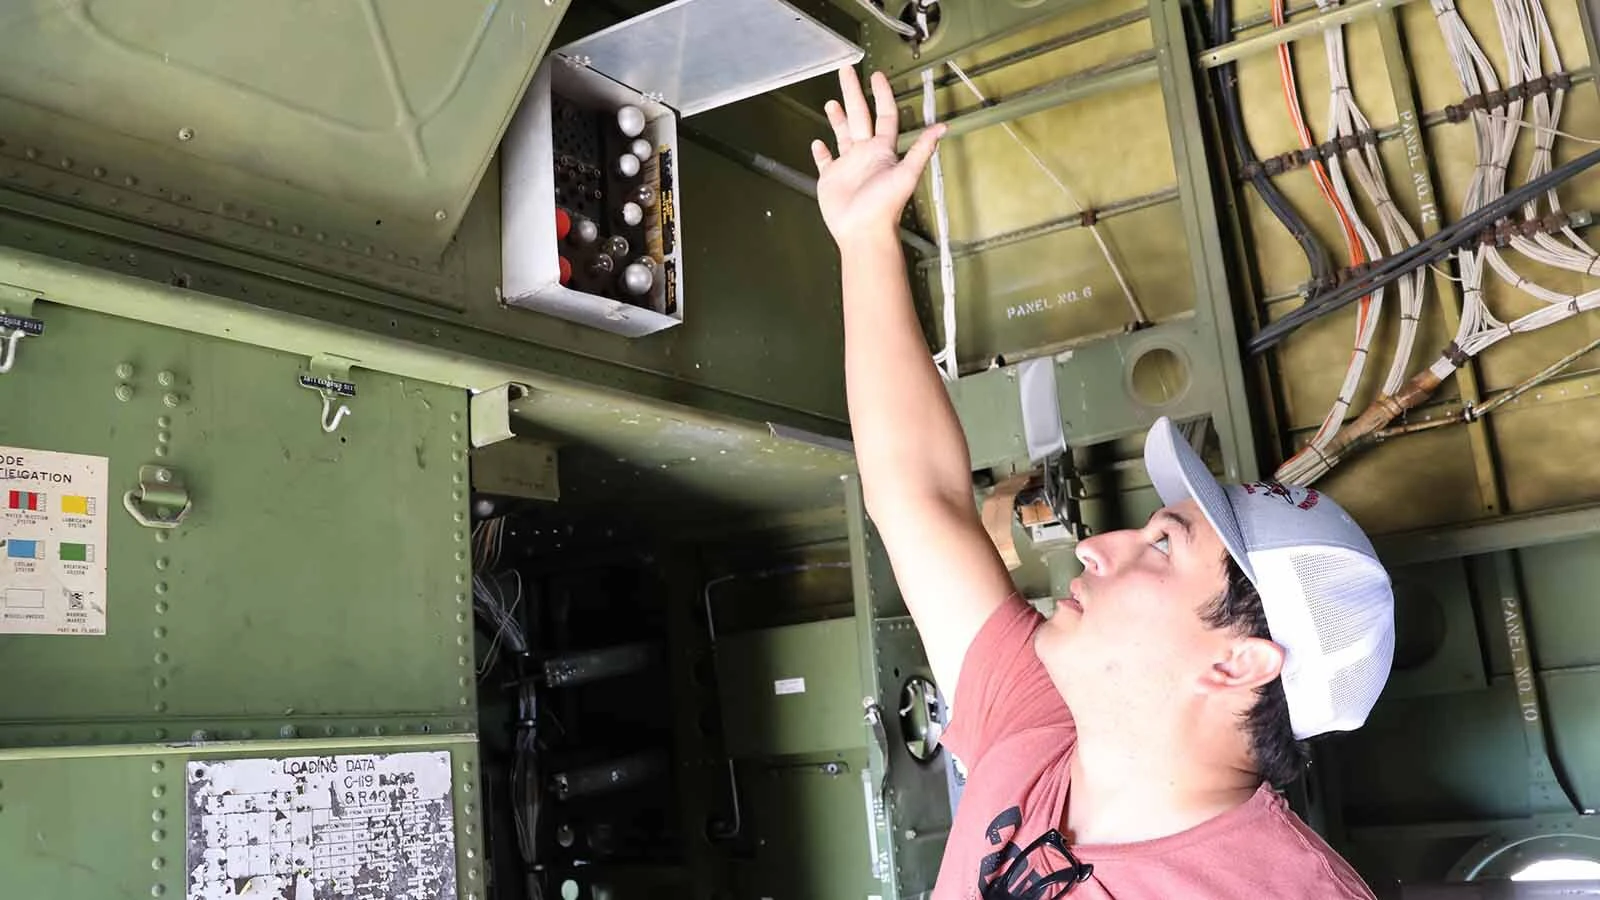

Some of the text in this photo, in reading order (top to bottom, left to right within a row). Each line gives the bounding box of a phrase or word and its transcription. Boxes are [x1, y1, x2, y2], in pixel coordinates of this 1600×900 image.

[1400, 111, 1420, 168] PANEL
[1007, 297, 1053, 320] PANEL
[1502, 597, 1522, 660] PANEL
[283, 759, 375, 774] LOADING DATA
